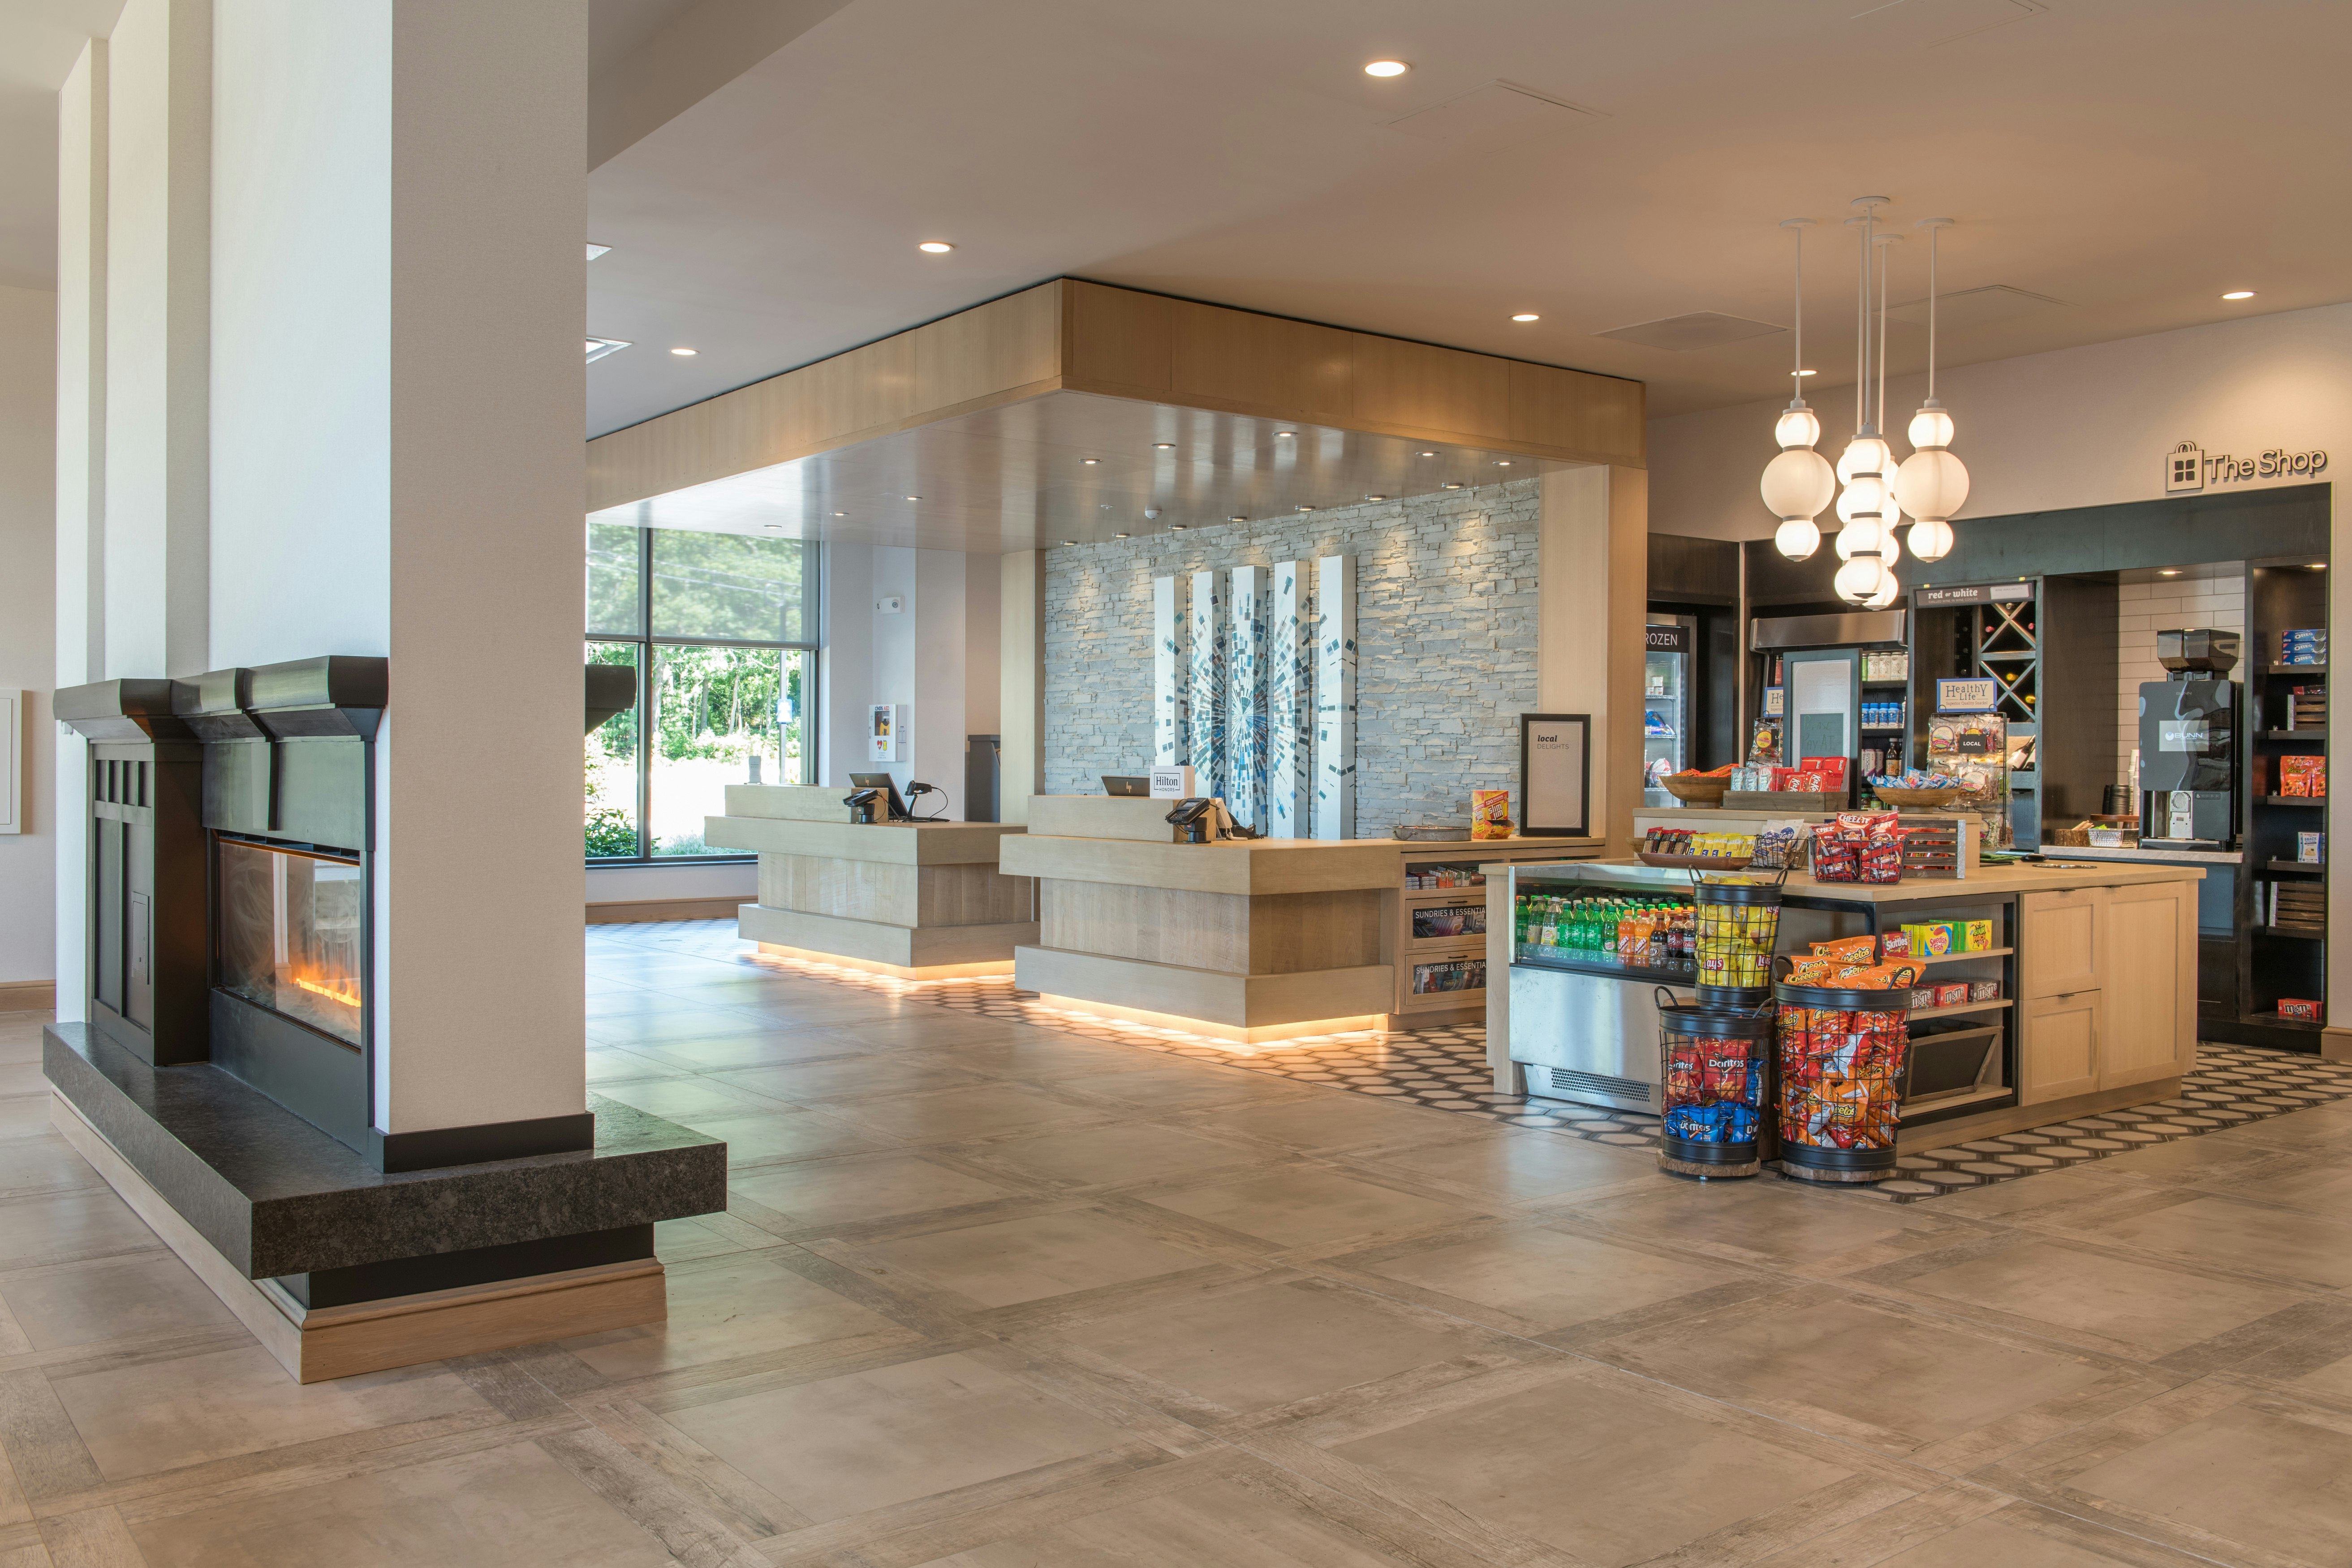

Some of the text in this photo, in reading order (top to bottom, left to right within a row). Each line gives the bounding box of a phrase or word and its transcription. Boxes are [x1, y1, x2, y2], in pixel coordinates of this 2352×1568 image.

[2205, 449, 2327, 479] The Shop
[1928, 590, 1943, 599] red
[1953, 589, 1978, 598] white
[1156, 776, 1178, 786] Hilton
[1416, 910, 1447, 918] SUNDRIES
[1974, 927, 1985, 935] SOUR
[1930, 936, 1947, 948] Swedish
[1973, 933, 1986, 943] PATCH
[1886, 937, 1908, 951] Skittles
[1934, 943, 1943, 952] Fish
[1416, 965, 1448, 974] SUNDRIES
[1788, 971, 1820, 983] Cheetos
[1709, 1059, 1745, 1068] Doritos
